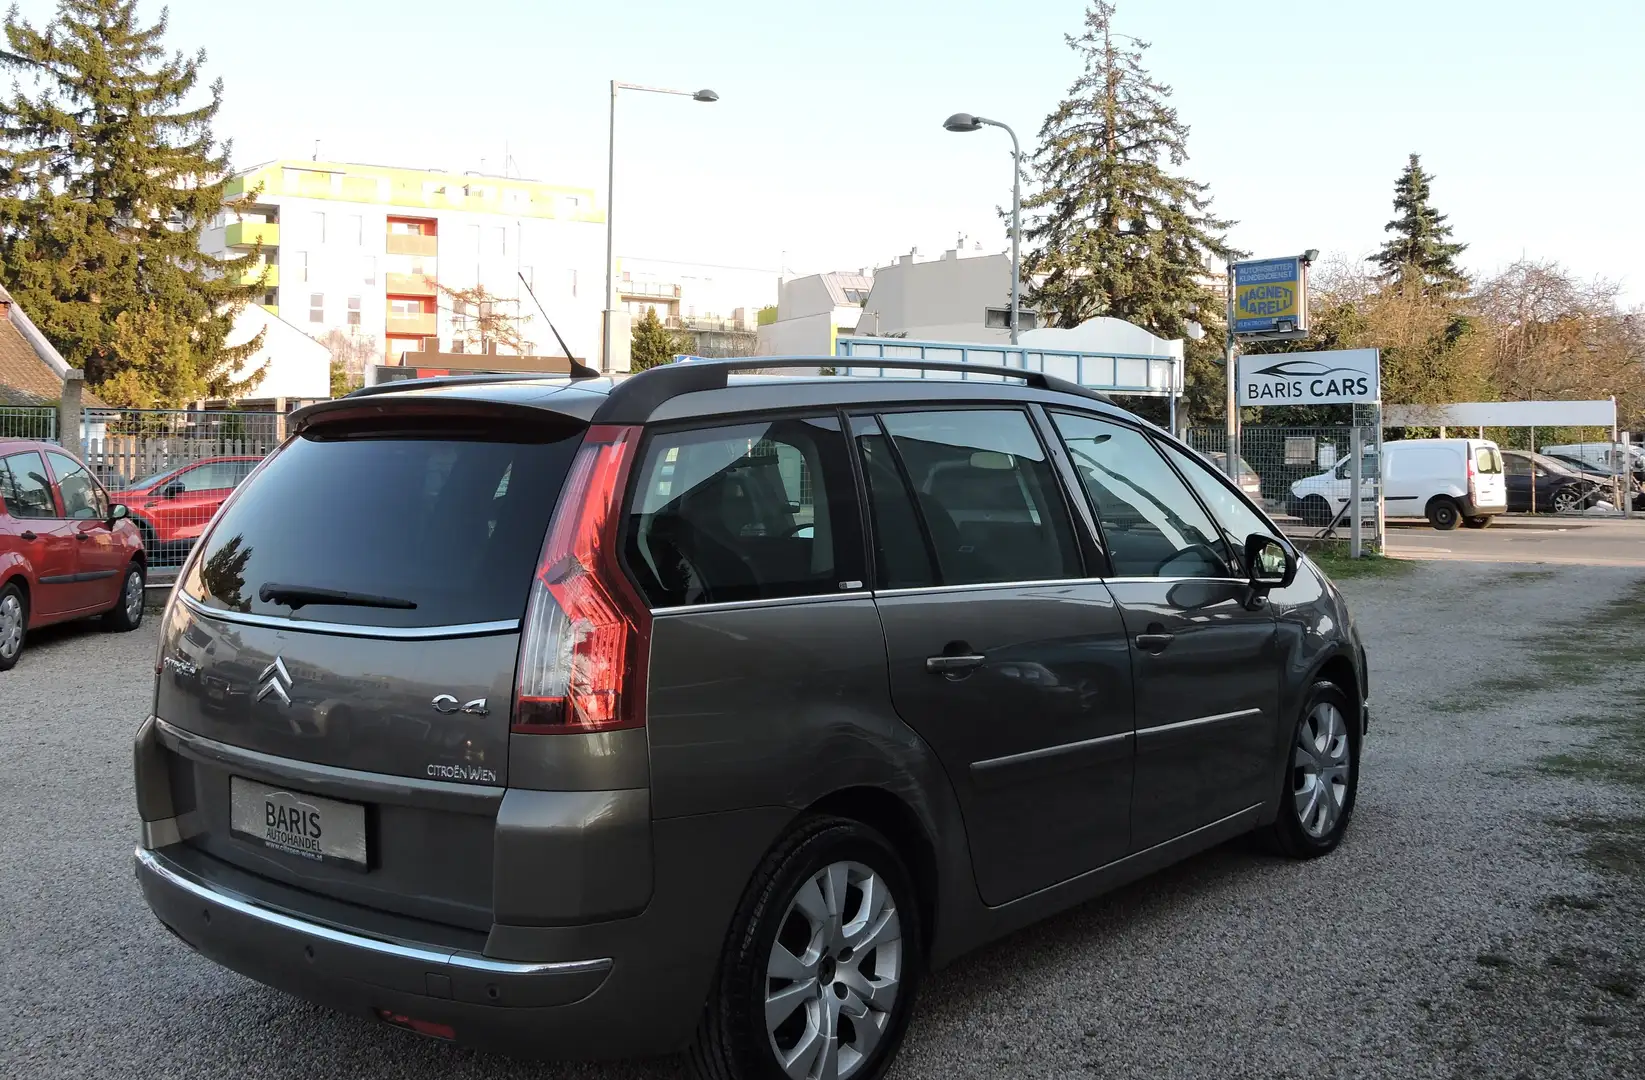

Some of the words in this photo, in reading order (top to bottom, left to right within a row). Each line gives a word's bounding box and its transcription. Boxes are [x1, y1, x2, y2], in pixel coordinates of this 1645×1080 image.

[1239, 271, 1293, 282] KUNDENDIENST
[1248, 381, 1302, 399] BARIS
[1309, 377, 1368, 397] CARS
[427, 764, 467, 779] CITROËN
[265, 801, 322, 839] BARIS
[266, 828, 322, 852] AUTOHANDEL
